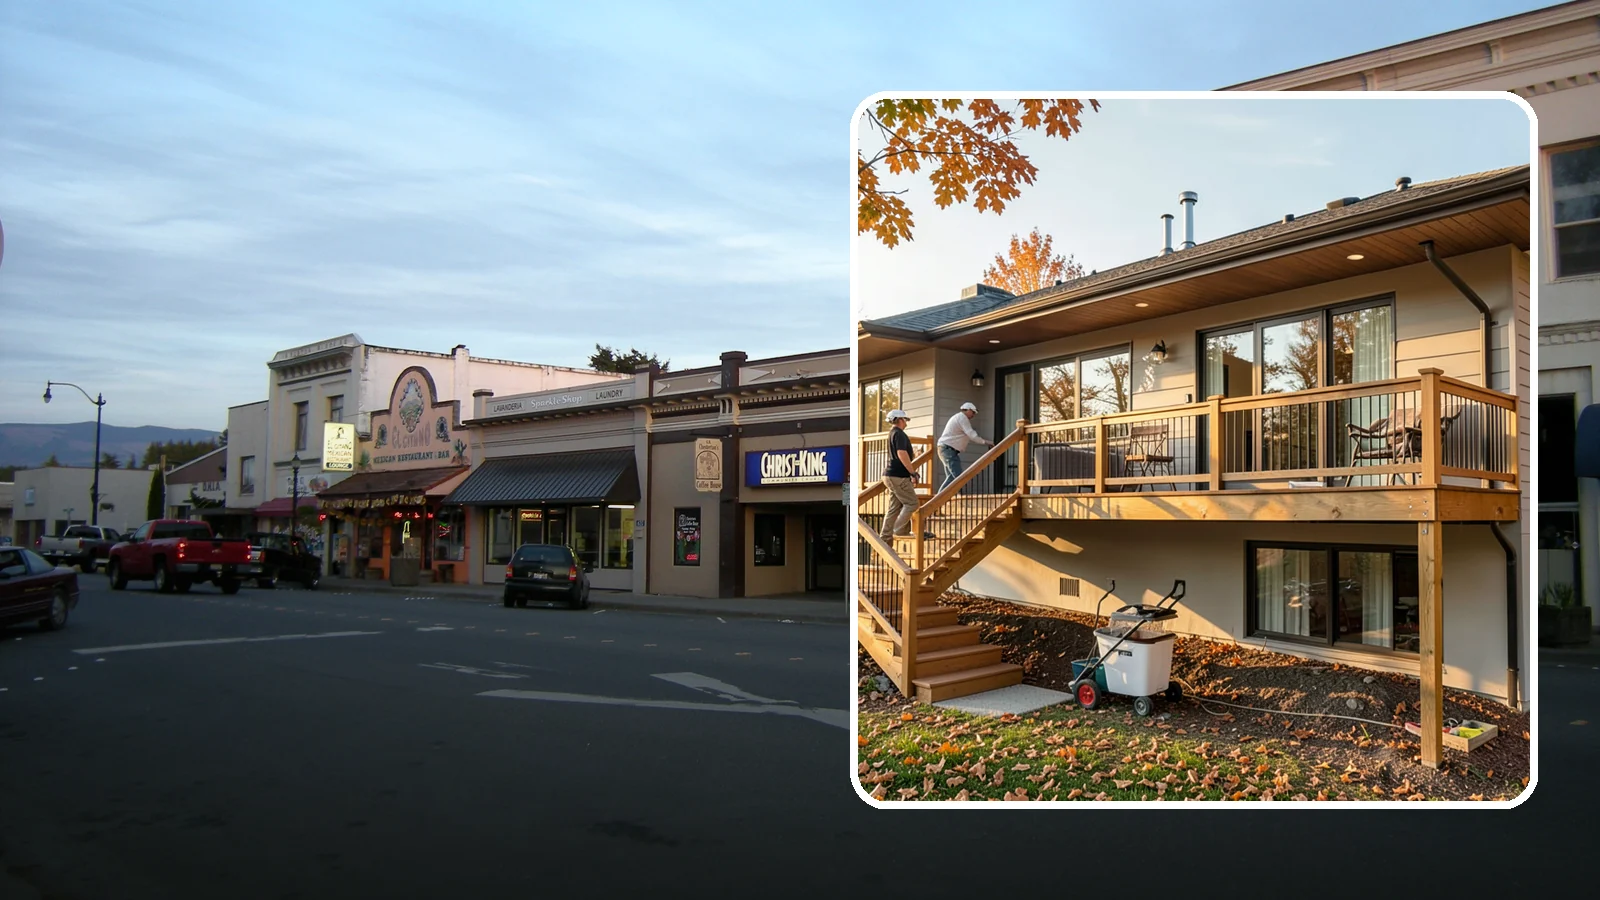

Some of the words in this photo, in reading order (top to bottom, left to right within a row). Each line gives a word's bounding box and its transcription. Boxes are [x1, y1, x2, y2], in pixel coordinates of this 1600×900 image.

[595, 389, 623, 400] LAUNDRY
[493, 402, 522, 412] LAVANDERIA
[530, 398, 560, 409] Sparkle
[561, 394, 583, 406] Shop
[373, 454, 396, 464] MEXICAN
[397, 451, 433, 462] RESTAURANT
[437, 450, 450, 459] BAR
[760, 452, 797, 478] CHRIST
[799, 449, 827, 476] KING
[709, 481, 722, 489] House
